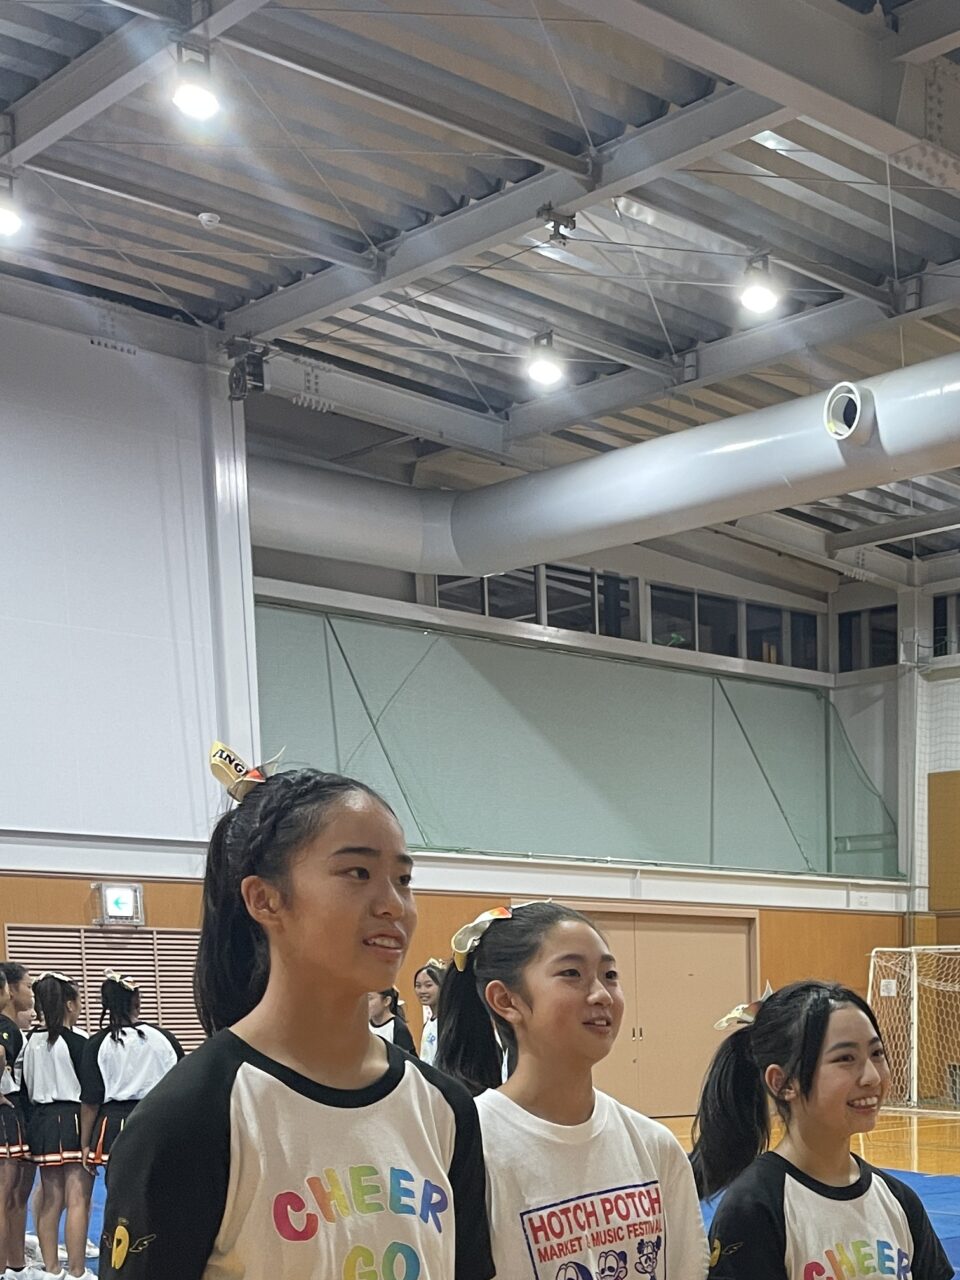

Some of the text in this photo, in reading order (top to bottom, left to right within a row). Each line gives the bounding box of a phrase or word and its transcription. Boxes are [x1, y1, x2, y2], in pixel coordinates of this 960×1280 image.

[212, 748, 249, 777] ANG
[272, 1165, 449, 1242] CHEER
[528, 1187, 662, 1244] HOTCH POTCH
[537, 1237, 583, 1264] MARKET
[591, 1226, 624, 1247] MUSIC
